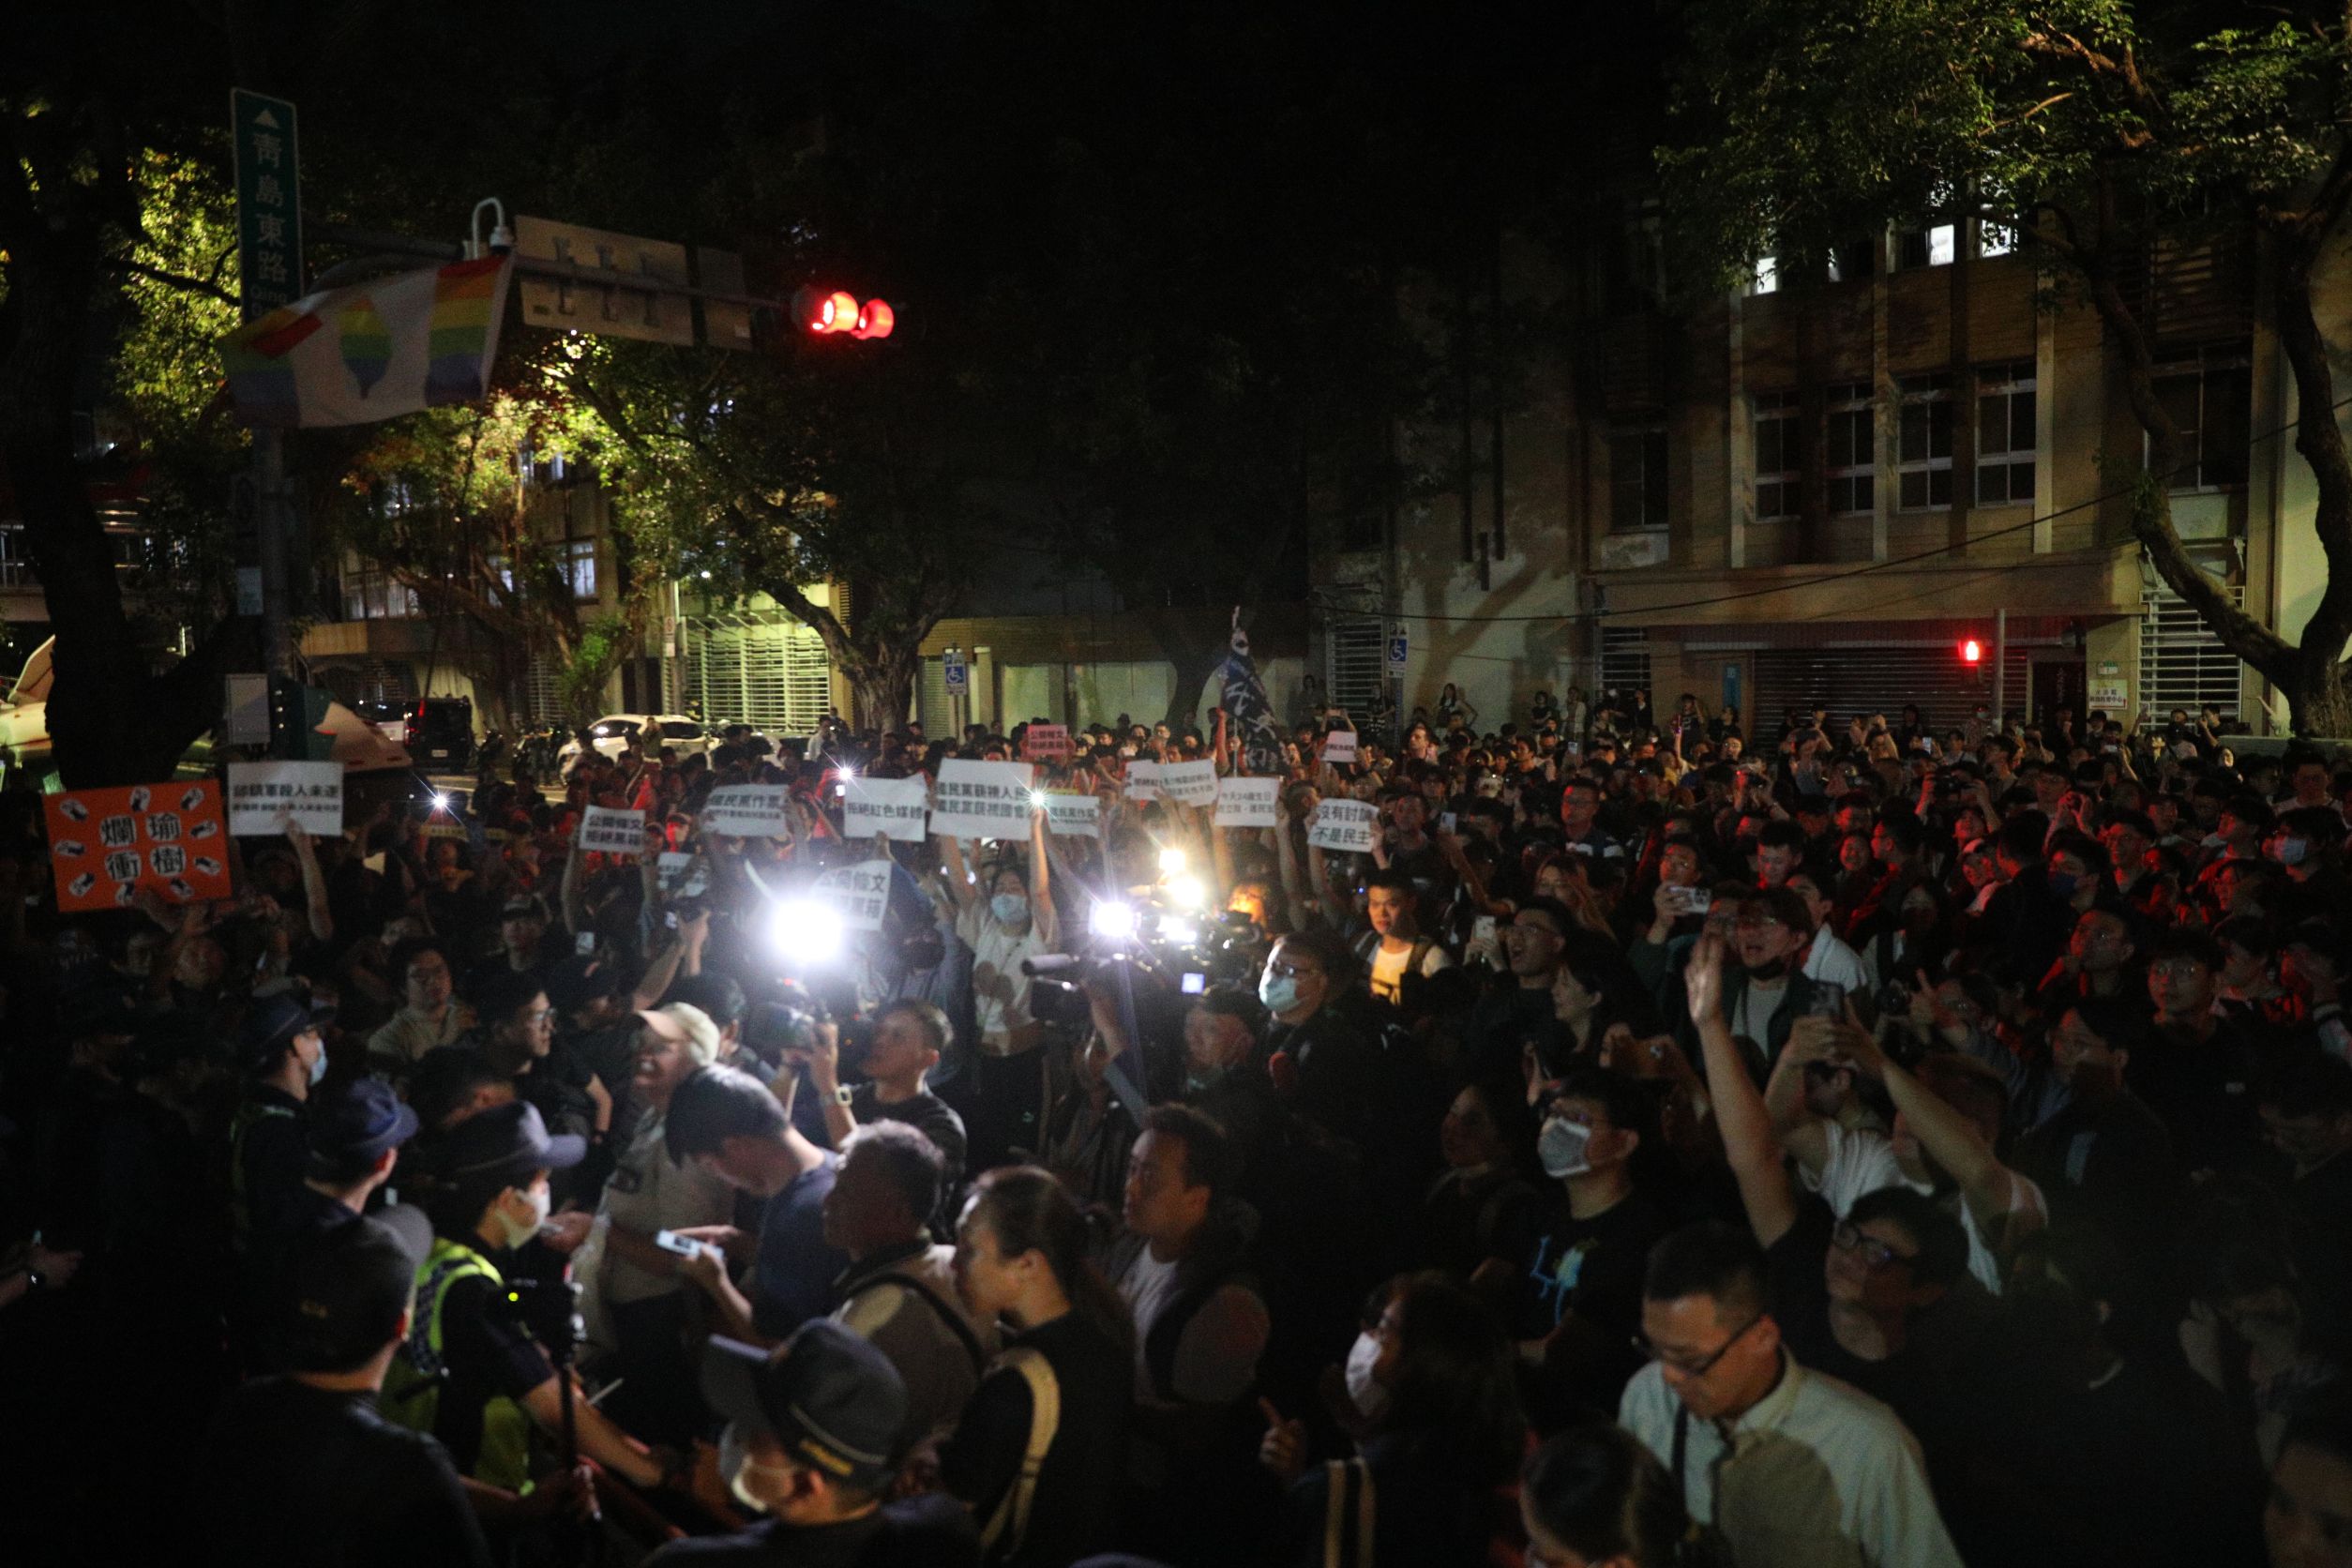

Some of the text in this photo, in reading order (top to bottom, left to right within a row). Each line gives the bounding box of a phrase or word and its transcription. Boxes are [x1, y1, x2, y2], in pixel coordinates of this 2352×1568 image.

[251, 132, 288, 285] 青島東路
[1313, 826, 1370, 845] 不是民主
